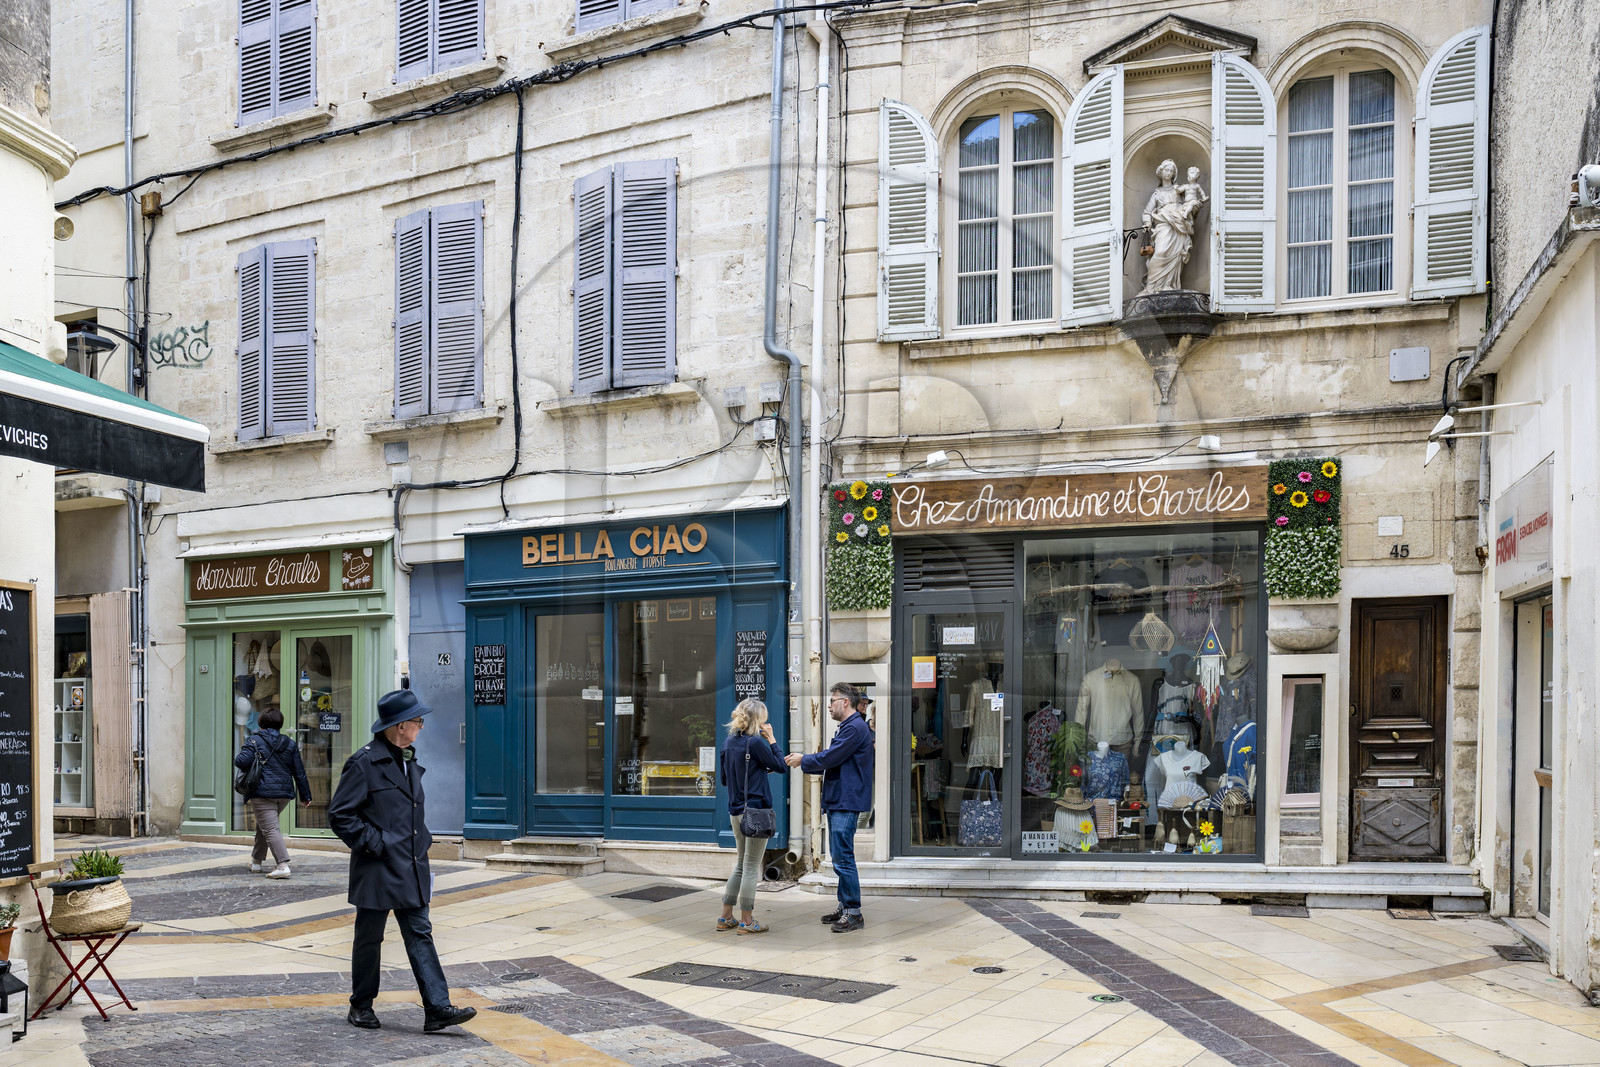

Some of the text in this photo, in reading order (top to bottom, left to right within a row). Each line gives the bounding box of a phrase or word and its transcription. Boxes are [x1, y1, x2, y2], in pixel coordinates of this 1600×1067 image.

[892, 471, 1250, 528] Chez Amandine et Charles
[522, 522, 708, 566] BELLA CIAO
[1389, 543, 1410, 558] 45
[1495, 528, 1517, 567] FRAM
[604, 554, 667, 573] BOULANGERIE UTOPISTE
[196, 553, 321, 591] Monsieur Charles
[474, 645, 504, 658] PAIN BIO
[438, 653, 451, 666] 43
[737, 654, 765, 666] PIZZA
[473, 663, 505, 676] BRIOCHE
[1022, 833, 1057, 841] AMANDINE
